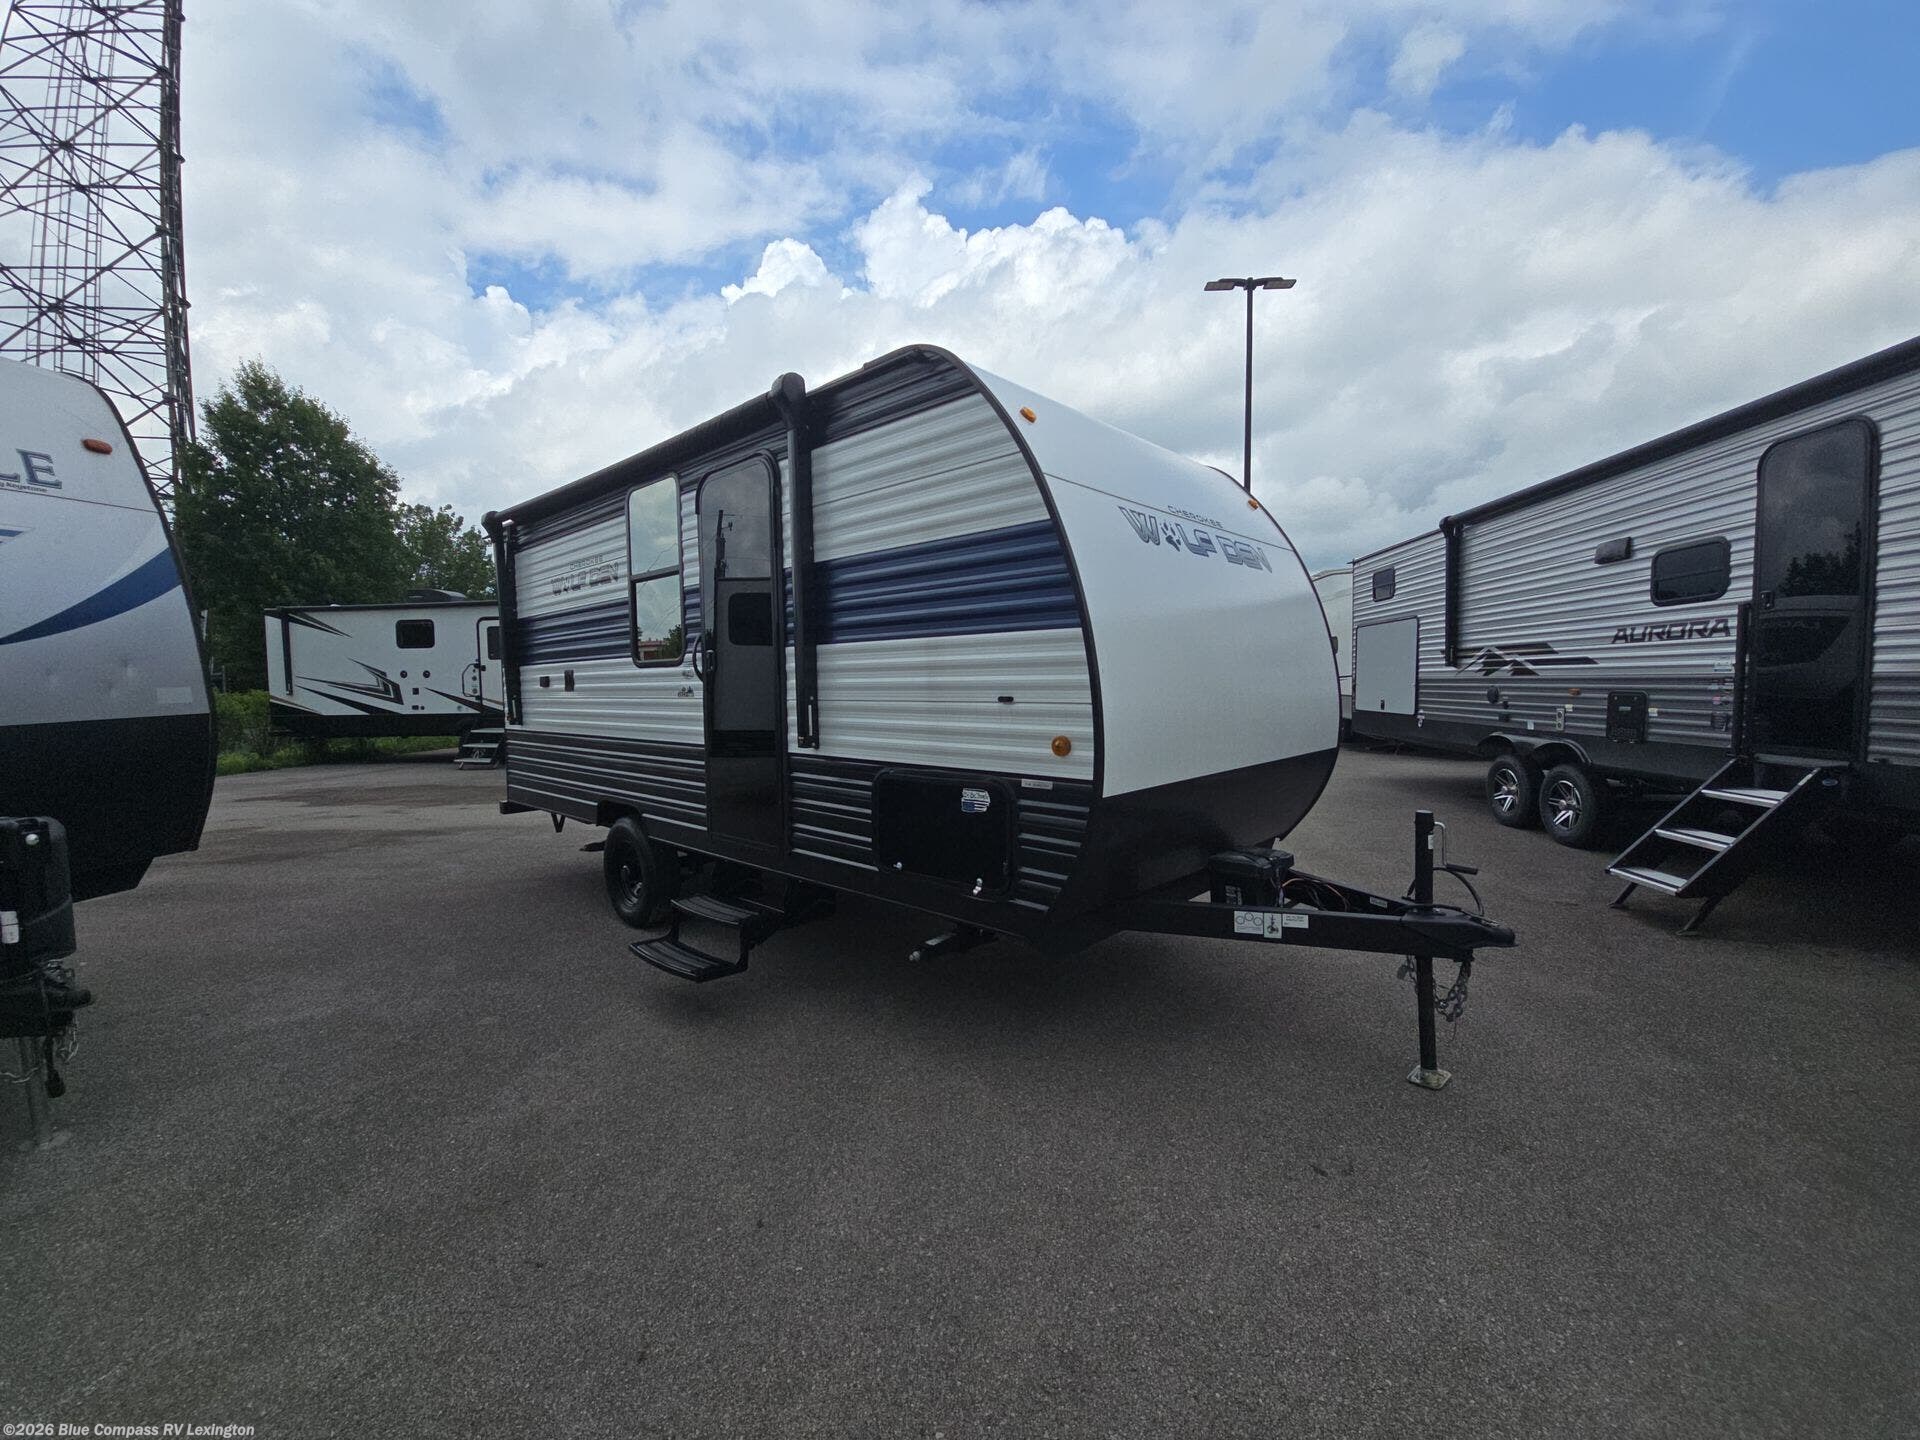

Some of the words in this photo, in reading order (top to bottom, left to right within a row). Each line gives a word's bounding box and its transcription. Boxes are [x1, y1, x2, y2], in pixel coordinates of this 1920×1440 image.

[1167, 505, 1224, 529] CHEROKEE
[569, 554, 603, 570] CHEROKEE
[1215, 534, 1273, 574] DEN
[590, 561, 619, 588] DEN
[1611, 618, 1731, 644] AURORA
